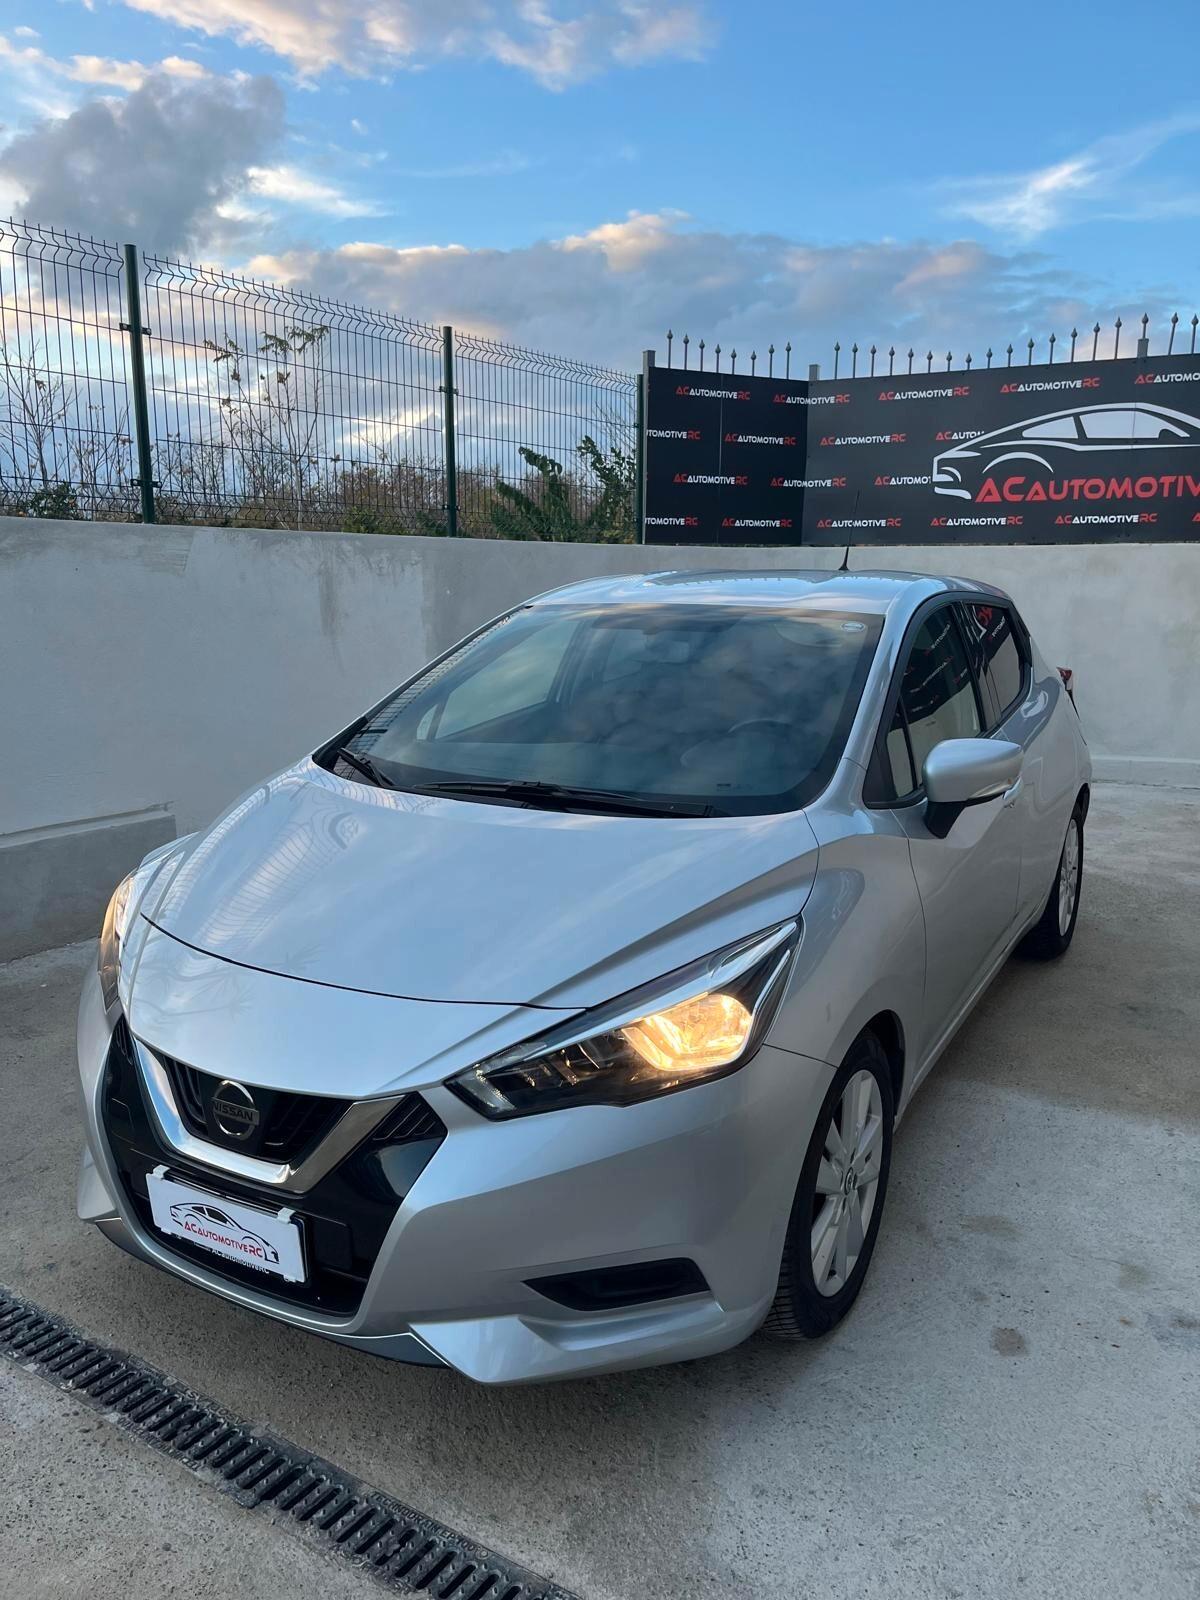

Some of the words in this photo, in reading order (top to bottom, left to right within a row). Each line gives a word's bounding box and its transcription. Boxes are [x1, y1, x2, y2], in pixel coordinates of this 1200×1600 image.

[1000, 377, 1100, 393] ACAUTOMOTIVERC
[675, 385, 750, 400] ACAUTOMOTIVERC
[879, 386, 970, 401] ACAUTOMOTIVERC
[773, 394, 850, 405] ACAUTOMOTIVERC
[725, 433, 796, 446] ACAUTOMOTIVERC
[820, 433, 907, 446] ACAUTOMOTIVERC
[673, 473, 748, 485] ACAUTOMOTIVERC
[770, 477, 846, 488] ACAUTOMOTIVERC
[722, 518, 792, 528] ACAUTOMOTIVERC
[930, 515, 1023, 527] ACAUTOMOTIVERC
[1055, 512, 1158, 525] ACAUTOMOTIVERC
[213, 1100, 253, 1120] NISSAN
[184, 1221, 263, 1258] ACAUTOMOTIVERC
